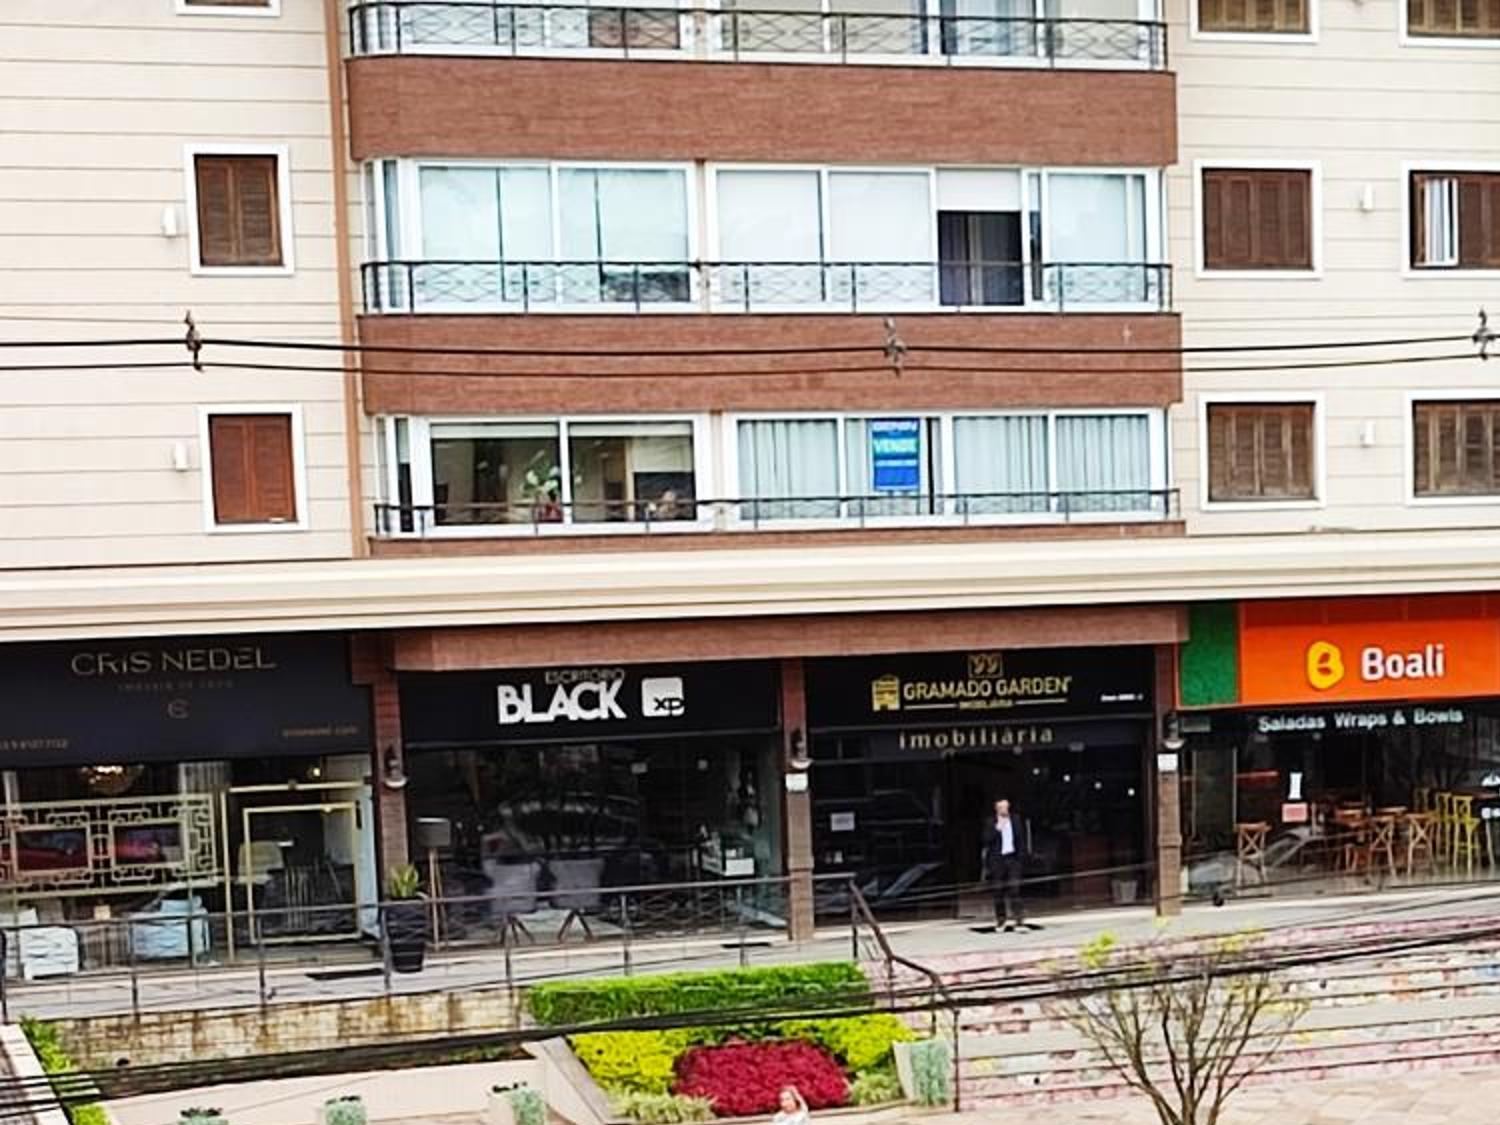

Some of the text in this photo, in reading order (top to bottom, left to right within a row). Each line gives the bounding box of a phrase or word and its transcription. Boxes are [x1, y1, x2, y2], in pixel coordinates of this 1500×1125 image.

[161, 648, 277, 672] NEDEL
[1361, 643, 1445, 681] Boali
[903, 676, 1069, 700] GRAMADO GARDEN
[497, 680, 627, 724] BLACK
[1258, 715, 1325, 733] Saladas
[1335, 711, 1387, 730] Wraps
[1393, 711, 1406, 725] &
